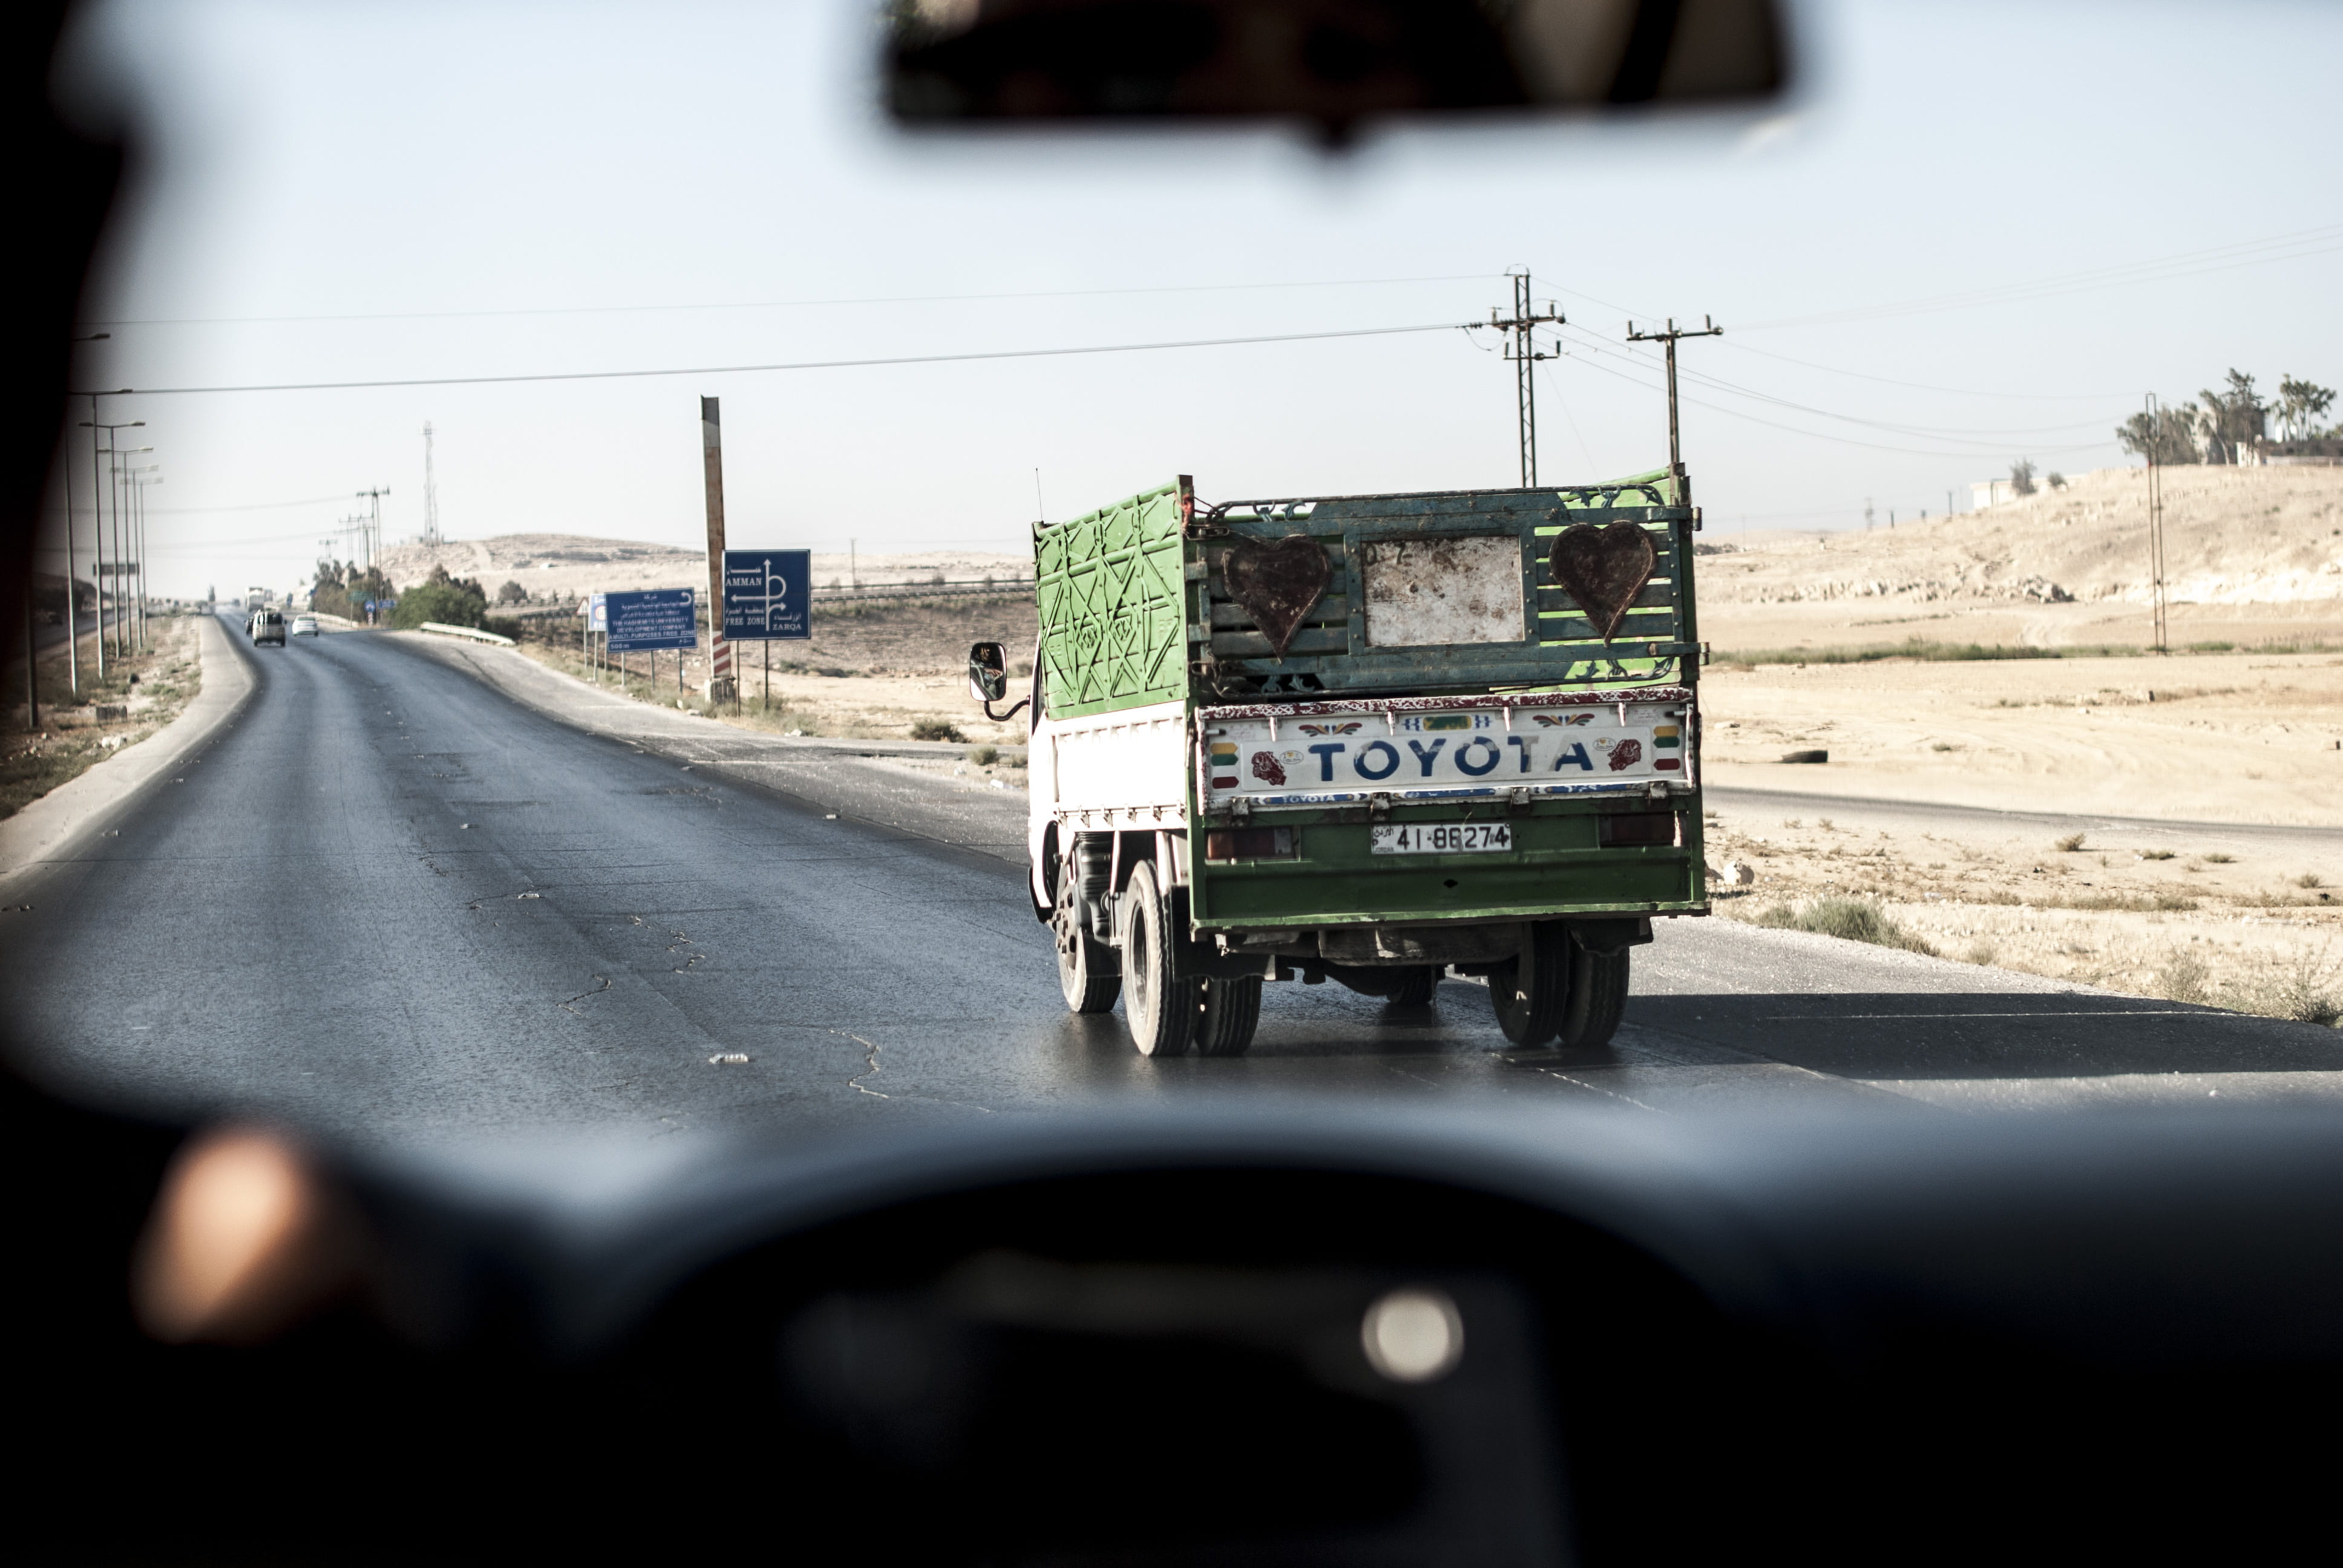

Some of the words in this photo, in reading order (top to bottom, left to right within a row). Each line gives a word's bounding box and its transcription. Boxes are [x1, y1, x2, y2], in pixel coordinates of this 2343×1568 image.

[726, 578, 762, 586] AMMAN
[1308, 735, 1593, 781] TOYOTA
[1283, 794, 1335, 804] TOYOTA
